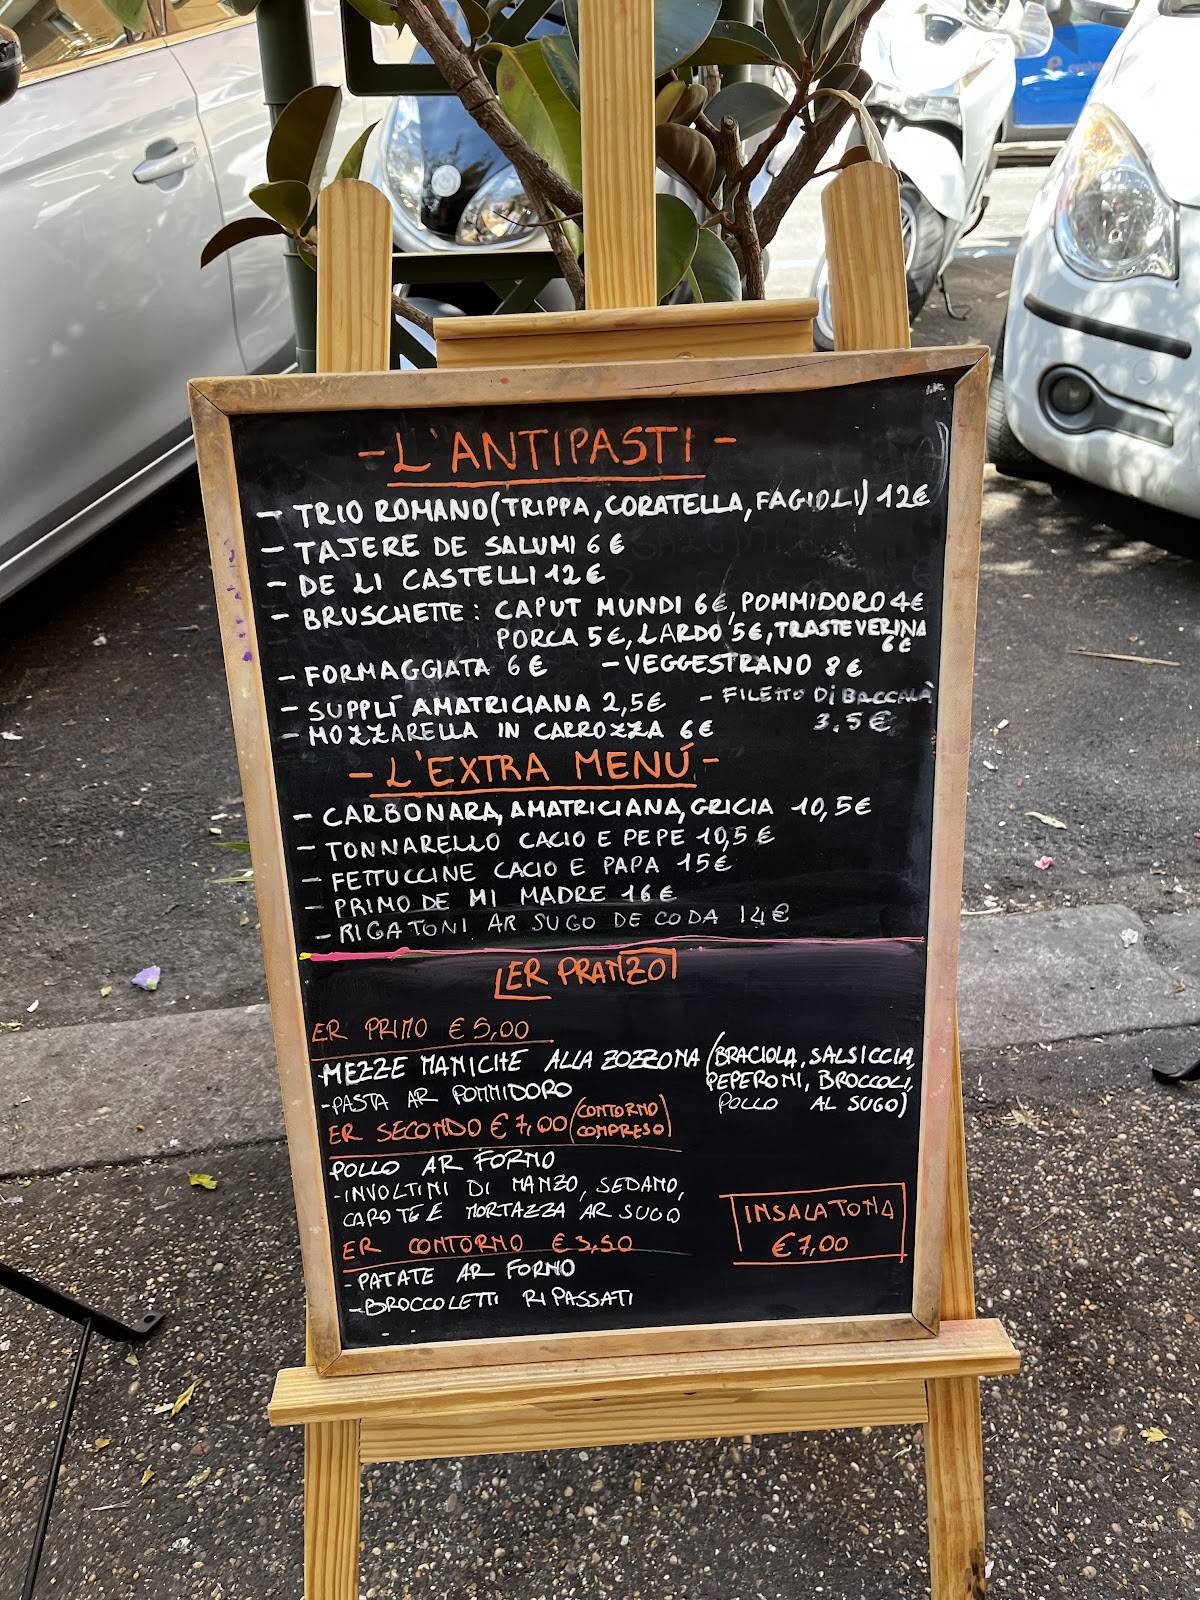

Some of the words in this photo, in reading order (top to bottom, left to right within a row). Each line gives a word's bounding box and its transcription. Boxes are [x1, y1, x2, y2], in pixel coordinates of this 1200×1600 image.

[394, 426, 691, 473] L'ANTIPASTI
[292, 500, 363, 528] TRIO
[375, 498, 488, 523] ROMANO
[605, 492, 752, 522] CORATELLA,
[756, 479, 868, 515] FAGIOLI)
[876, 484, 930, 508] 12€
[293, 534, 420, 565] TAJERE
[433, 536, 467, 557] DE
[485, 535, 575, 556] SALUMI
[299, 575, 335, 598] DE
[403, 565, 536, 590] CASTELLI
[495, 597, 581, 620] CAPUT
[597, 596, 681, 617] MUNDI
[742, 591, 885, 613] POMMIDORO
[890, 591, 923, 612] 4€
[497, 628, 579, 649] PORCA
[637, 620, 722, 645] LARDO
[304, 656, 490, 687] FORMAGGIATA
[412, 694, 590, 717] AMATRICIANA
[603, 692, 666, 717] 2,5€
[722, 686, 805, 703] FILETTO
[309, 721, 478, 746] MOZZARELLA
[498, 722, 519, 738] IN
[534, 720, 664, 740] CARROZZA
[386, 750, 549, 787] L'EXTRA
[575, 742, 695, 780] MENÚ
[323, 802, 503, 827] CARBONARA,
[511, 798, 685, 824] AMATRICIANA,
[691, 798, 773, 815] GRICIA
[791, 796, 871, 822] 10,5€
[325, 833, 500, 861] TONNARELLO
[519, 831, 585, 849] CACIO
[598, 831, 611, 847] E
[624, 829, 684, 846] PEPE
[332, 863, 476, 892] FETTUCCINE
[494, 861, 557, 879] CACIO
[570, 858, 585, 876] E
[604, 856, 659, 874] PAPA
[335, 895, 410, 918] PRIMO
[422, 892, 450, 910] DE
[470, 889, 496, 907] MI
[521, 886, 605, 906] MADRE
[340, 918, 466, 943] RIGATONI
[488, 913, 516, 933] AR
[532, 913, 595, 931] SUGO
[615, 912, 642, 927] DE
[655, 909, 718, 925] CODA
[506, 958, 548, 990] ER
[558, 955, 665, 985] PRANZO
[312, 1019, 348, 1041] ER
[365, 1017, 427, 1040] PRIMO
[420, 1049, 529, 1077] MANICHE
[544, 1048, 592, 1072] ALLA
[601, 1048, 700, 1070] ZOZZONA
[809, 1045, 914, 1070] SALSICCIA,
[408, 1087, 438, 1108] AR
[452, 1079, 572, 1105] POMMIDORO
[706, 1072, 809, 1092] PEPERONI,
[818, 1069, 913, 1092] BROCCOLI,
[719, 1092, 778, 1114] POLLO
[810, 1096, 837, 1111] AL
[847, 1092, 907, 1118] SUGO)
[329, 1123, 363, 1144] ER
[377, 1118, 481, 1142] SECONDO
[330, 1161, 400, 1181] POLLO
[422, 1155, 463, 1176] AR
[473, 1149, 555, 1171] FORNO
[466, 1179, 489, 1196] DI
[343, 1204, 424, 1227] CAROTE
[426, 1202, 442, 1221] E
[466, 1201, 565, 1219] MORTAZZA
[579, 1202, 612, 1220] AR
[745, 1196, 894, 1223] INSALATONA
[343, 1237, 381, 1260] ER
[409, 1234, 523, 1254] CONTORNO
[456, 1263, 495, 1283] AR
[506, 1259, 575, 1279] FORNO
[522, 1287, 633, 1307] RIPASSATI
